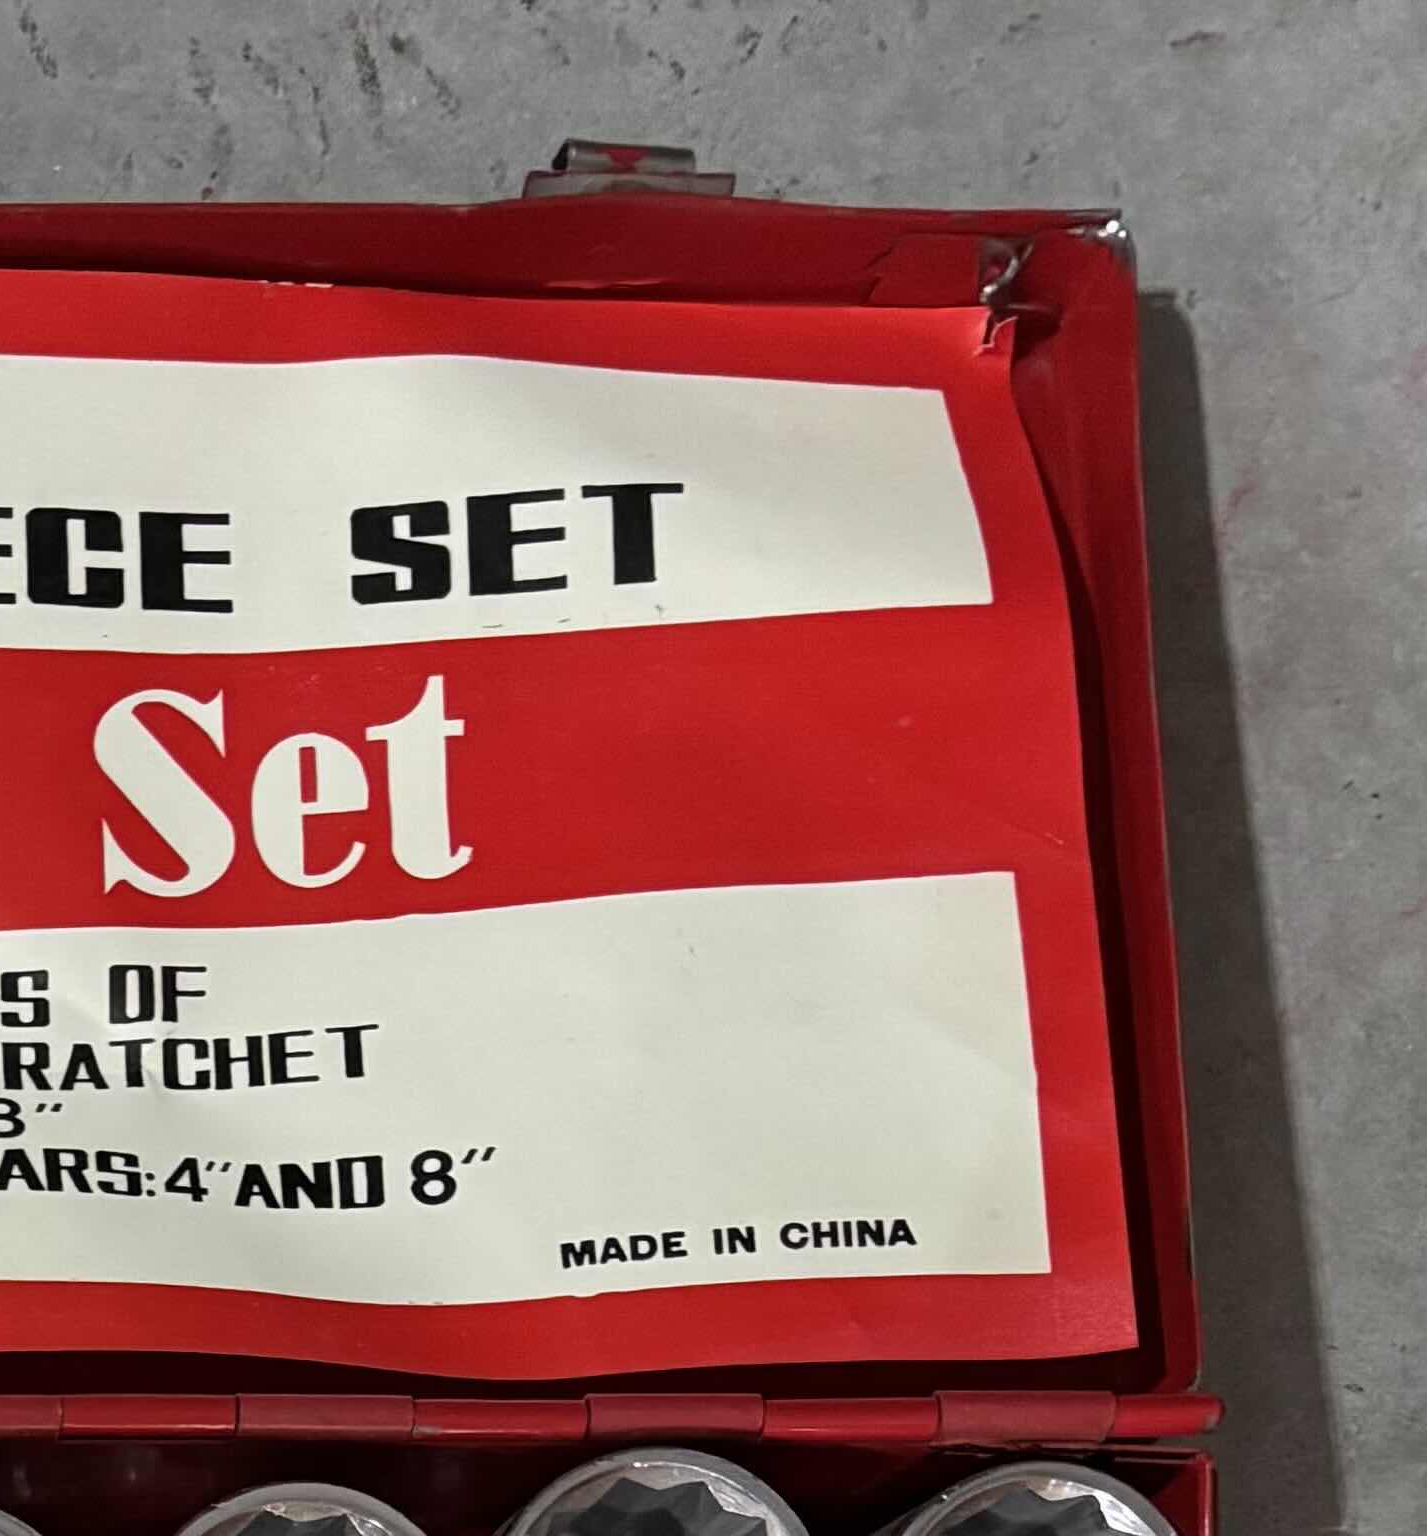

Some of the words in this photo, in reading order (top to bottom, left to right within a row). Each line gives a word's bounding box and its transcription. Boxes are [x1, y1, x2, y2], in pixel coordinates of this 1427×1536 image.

[348, 481, 685, 606] SET
[92, 674, 474, 898] Set
[107, 963, 208, 1026] OF
[0, 1022, 381, 1093] RATCHET
[233, 1154, 387, 1211] AND
[559, 1230, 689, 1270] MADE
[711, 1225, 758, 1256] IN
[778, 1217, 918, 1251] CHINA
